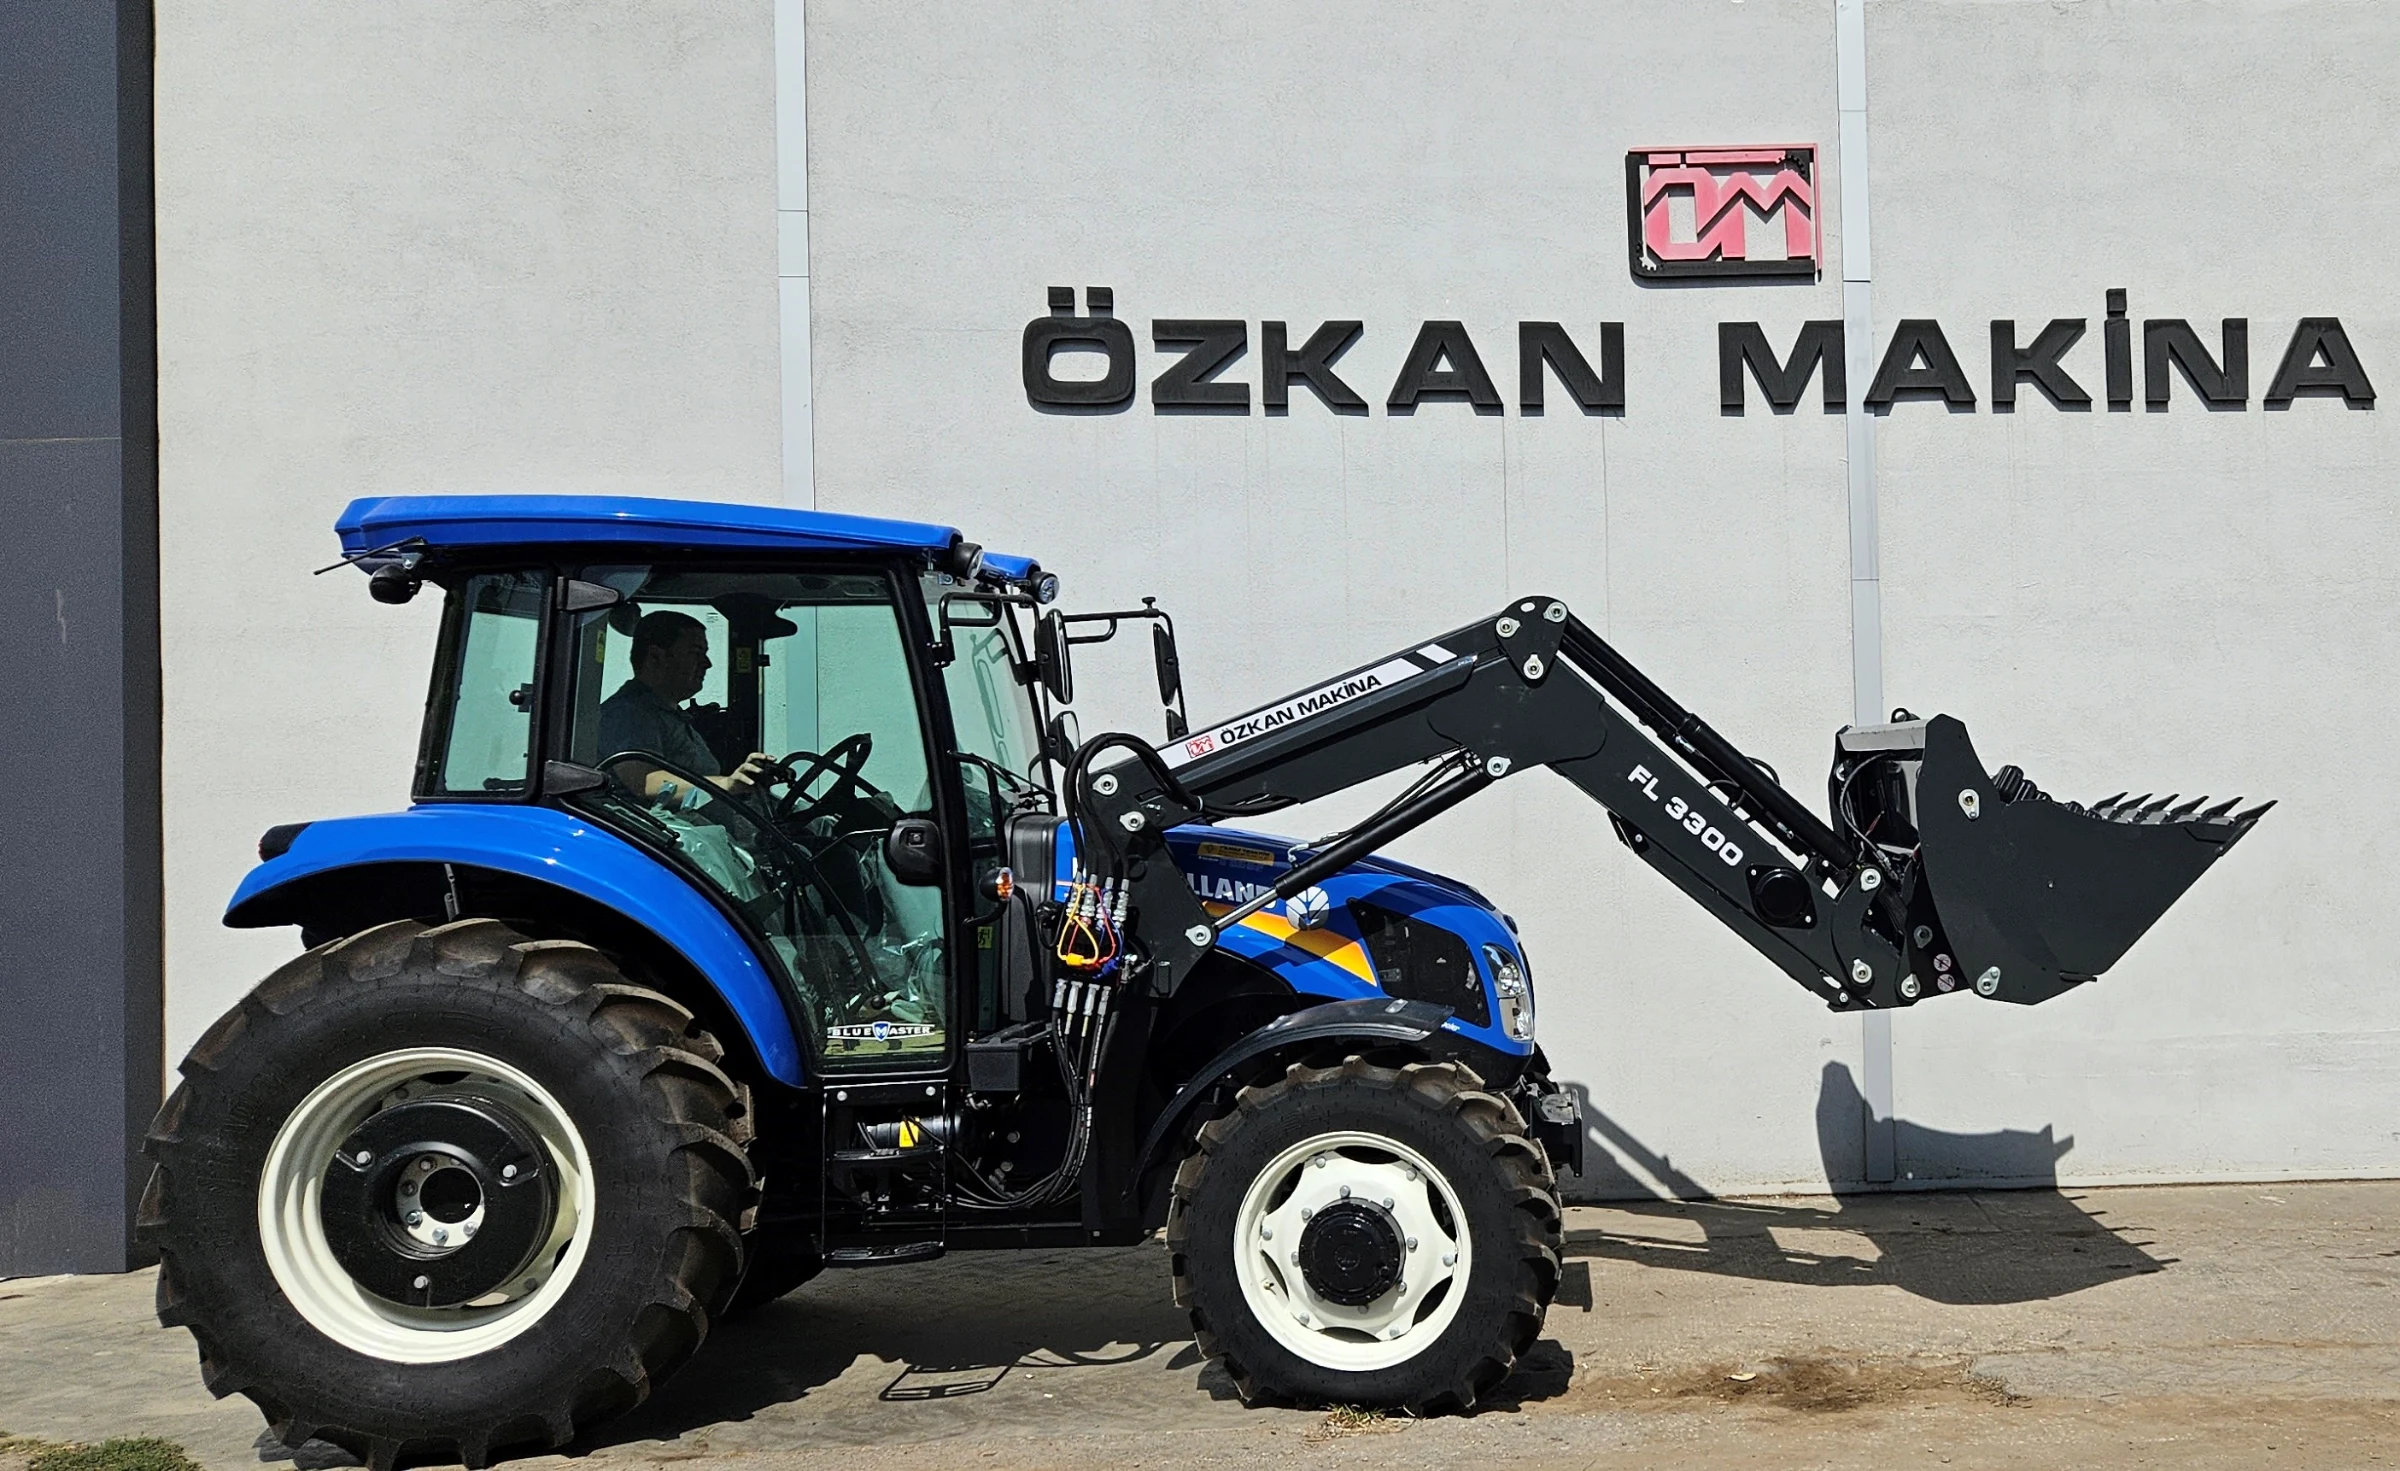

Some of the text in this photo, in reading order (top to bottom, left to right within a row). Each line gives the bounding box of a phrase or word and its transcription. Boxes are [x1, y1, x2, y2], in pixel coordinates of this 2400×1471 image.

[1022, 286, 2377, 417] ÖZKAN MAKİNA
[1219, 674, 1383, 745] ÖZKAN MAKİNA
[1627, 763, 1744, 867] FL 3300
